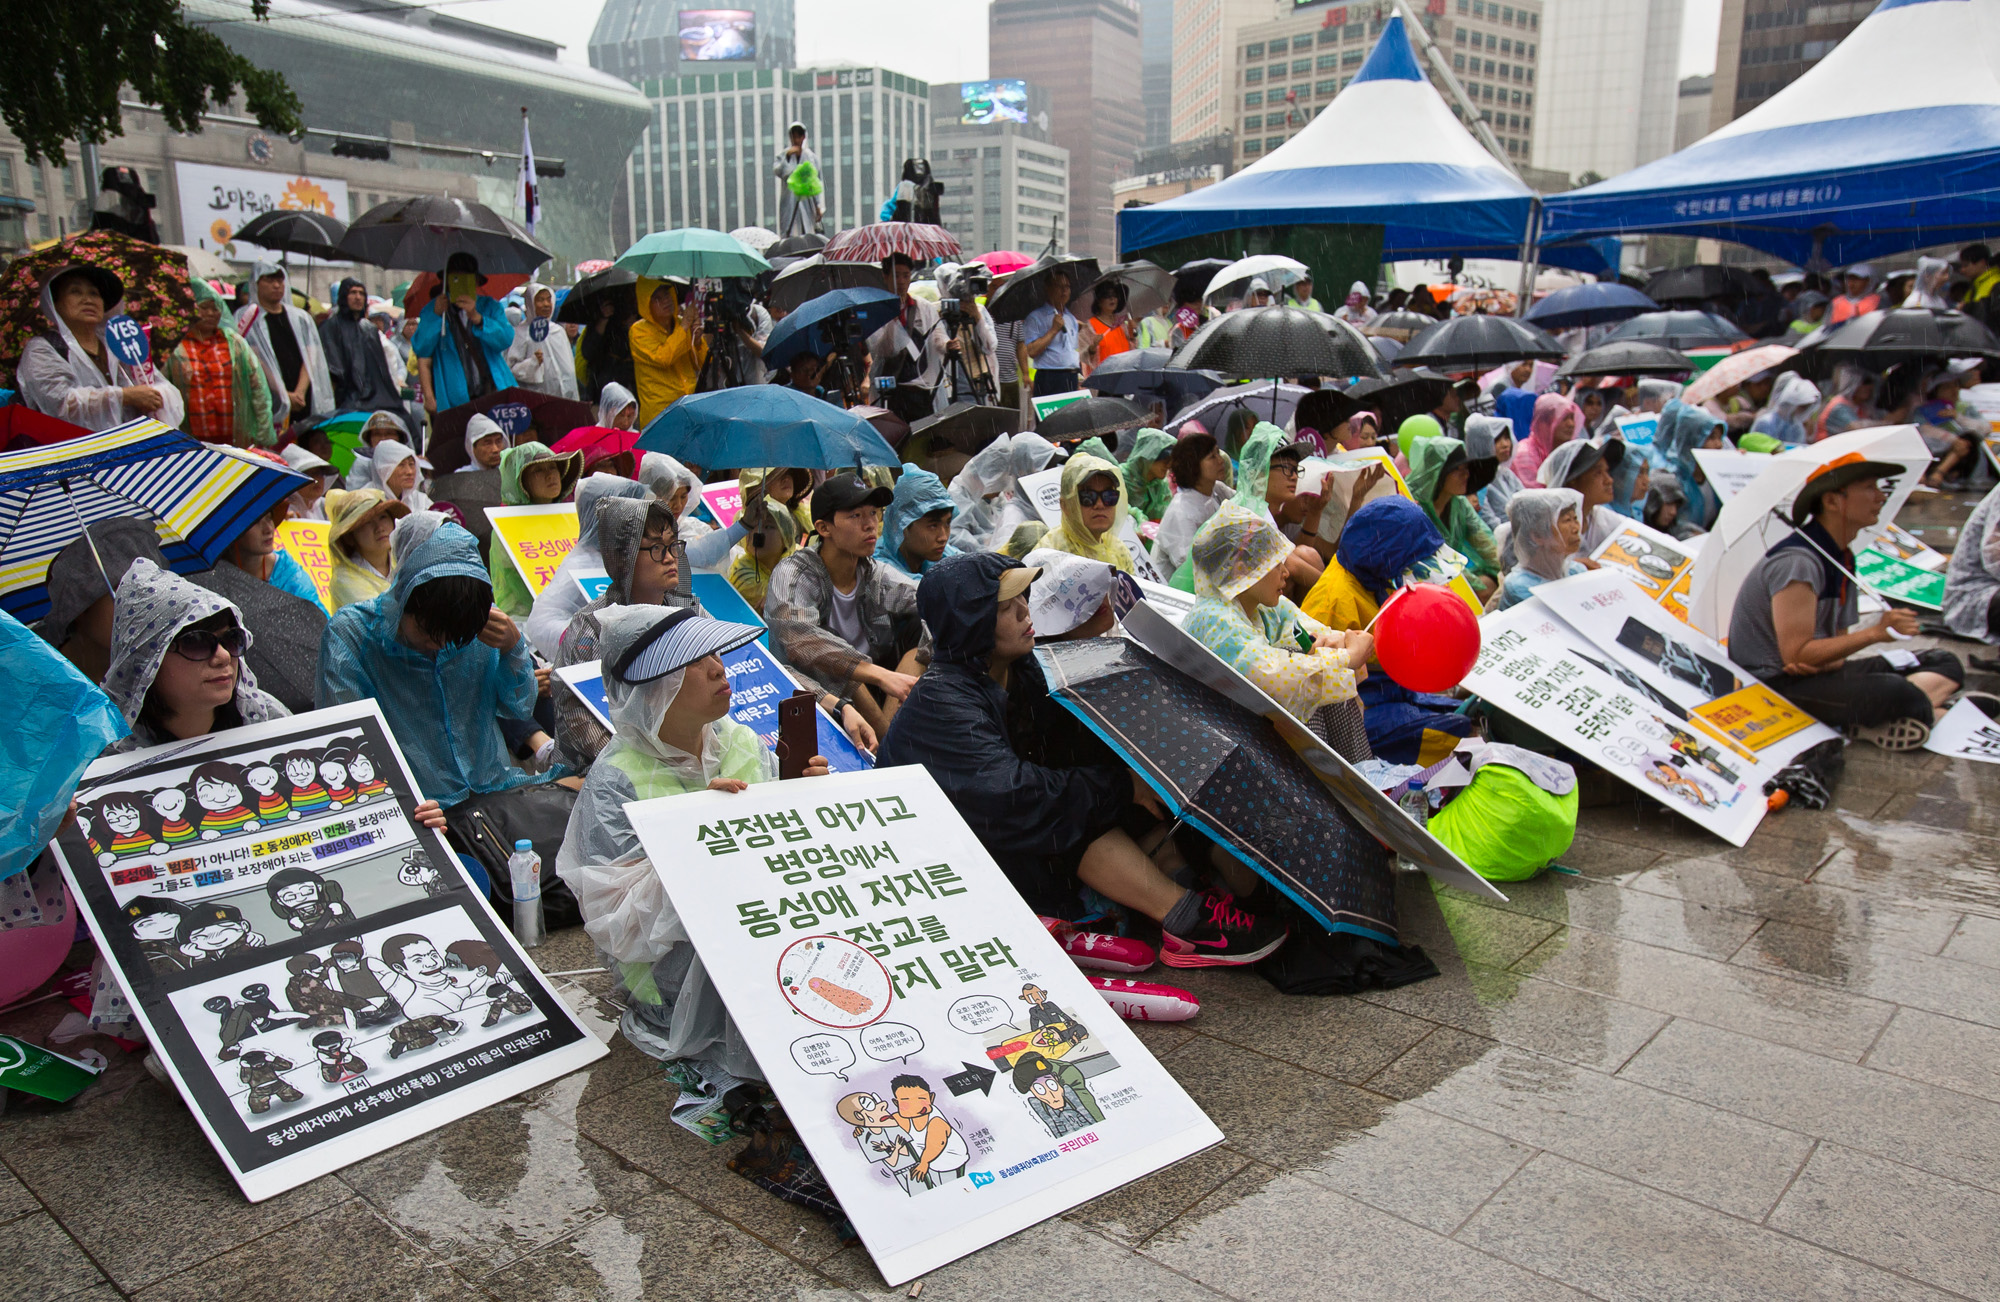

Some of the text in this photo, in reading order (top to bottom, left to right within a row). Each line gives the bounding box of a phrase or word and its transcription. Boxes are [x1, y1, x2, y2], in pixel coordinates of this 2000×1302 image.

[108, 319, 139, 340] YES
[532, 319, 547, 329] YES
[1515, 677, 1561, 709] 동성애
[1556, 685, 1603, 717] 군장교를
[734, 703, 776, 723] 배우고
[1575, 704, 1625, 743] 두둔하지
[696, 795, 918, 857] 설정법 어기고
[111, 806, 402, 886] 동성애는 범죄가 아니다! 군 동성애자의 인권을 보장하라!
[151, 829, 386, 894] 그들도 인권을 보장해야 되는 사회의 약자다!
[763, 840, 900, 886] 병영에서
[735, 863, 968, 939] 동성애 저지른
[838, 915, 951, 958] 장교를
[939, 936, 1020, 983] 말라
[802, 1040, 832, 1054] 김병장님
[806, 1049, 829, 1060] 이러지
[872, 1042, 894, 1053] 가만히
[266, 1029, 552, 1147] 동성애자에게 성추행(성폭행) 당한 이들의 인권은??
[348, 1077, 367, 1092] 유서
[956, 1078, 970, 1088] 1년
[968, 1127, 990, 1142] 군생활
[974, 1136, 996, 1149] 편하게
[1058, 1131, 1100, 1154] 국민대회
[979, 1146, 994, 1156] 가자
